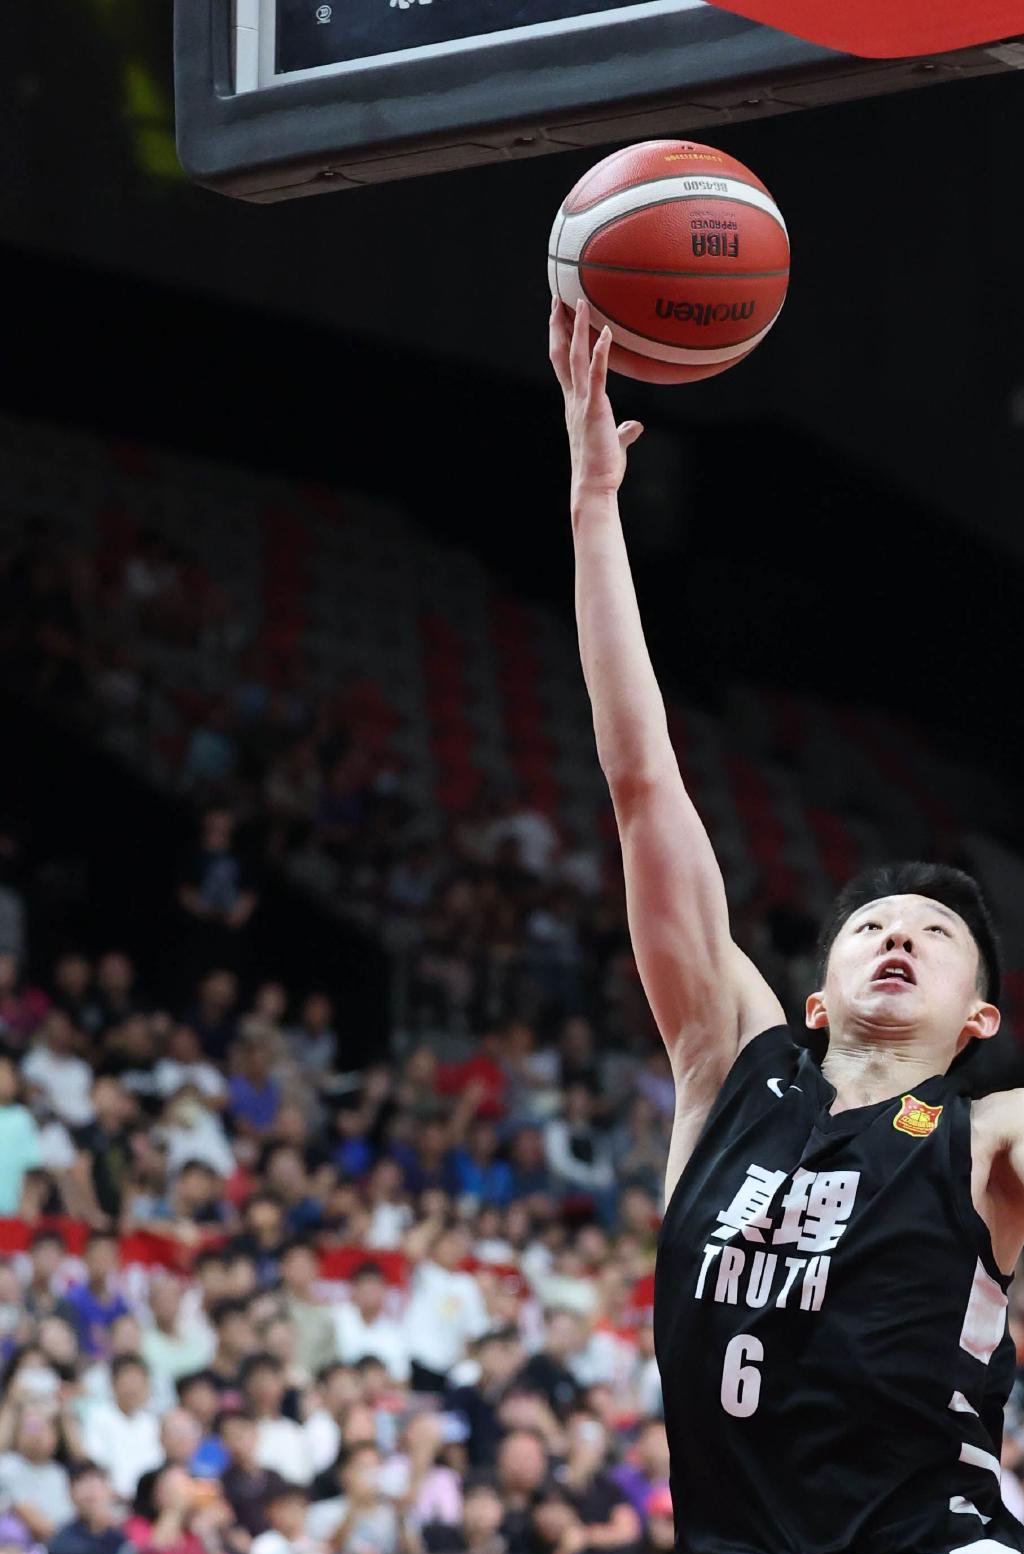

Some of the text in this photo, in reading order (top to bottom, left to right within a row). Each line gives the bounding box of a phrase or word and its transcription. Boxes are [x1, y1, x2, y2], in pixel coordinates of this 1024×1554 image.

[684, 181, 728, 193] BG4500
[690, 219, 738, 231] APPROVED
[691, 232, 739, 257] FIBA
[656, 298, 755, 327] molten
[711, 1164, 860, 1253] 真理
[694, 1243, 831, 1311] TRUTH
[720, 1333, 765, 1418] 6
